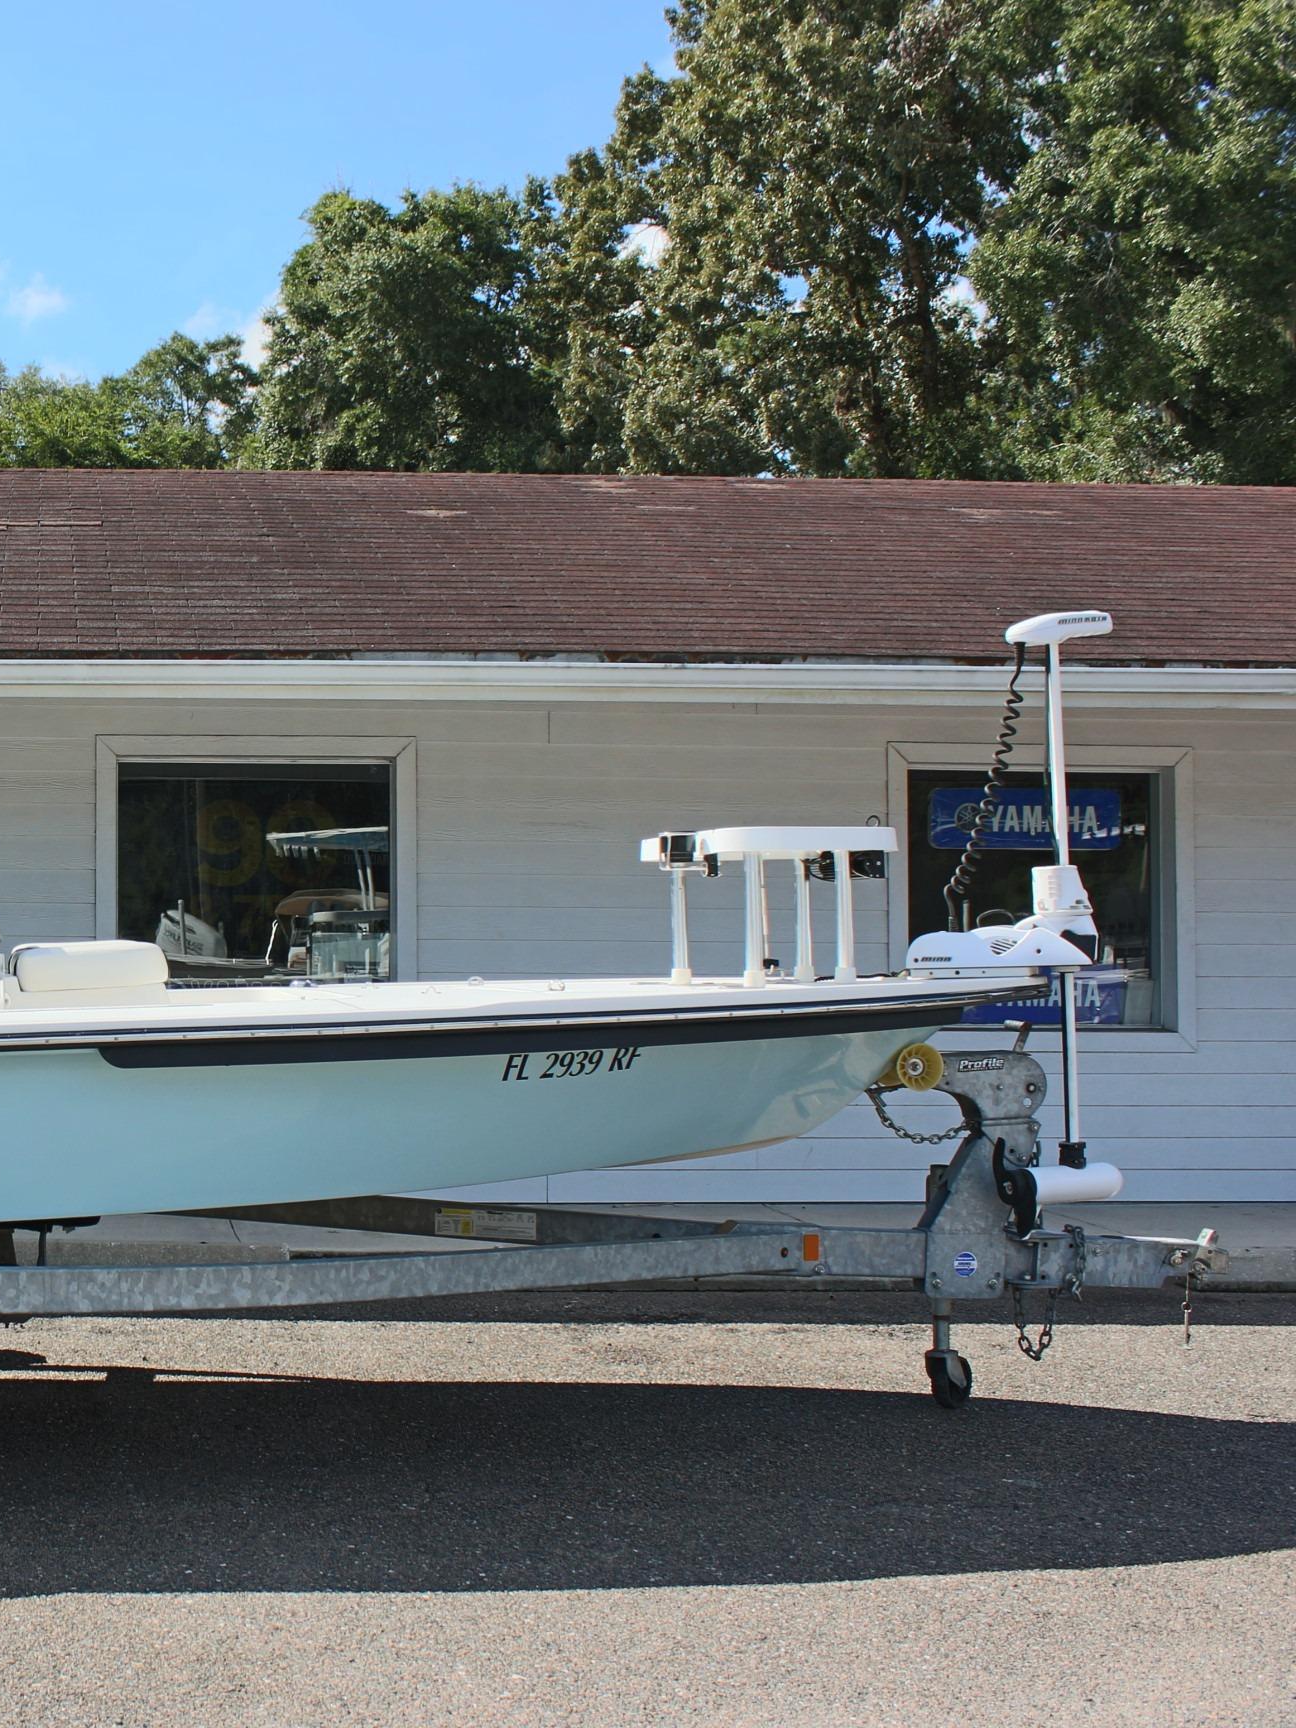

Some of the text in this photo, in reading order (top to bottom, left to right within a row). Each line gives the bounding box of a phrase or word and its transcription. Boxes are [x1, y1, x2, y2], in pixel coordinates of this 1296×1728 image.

[502, 1047, 641, 1081] FL 2939 RF
[959, 1058, 1004, 1069] Profile
